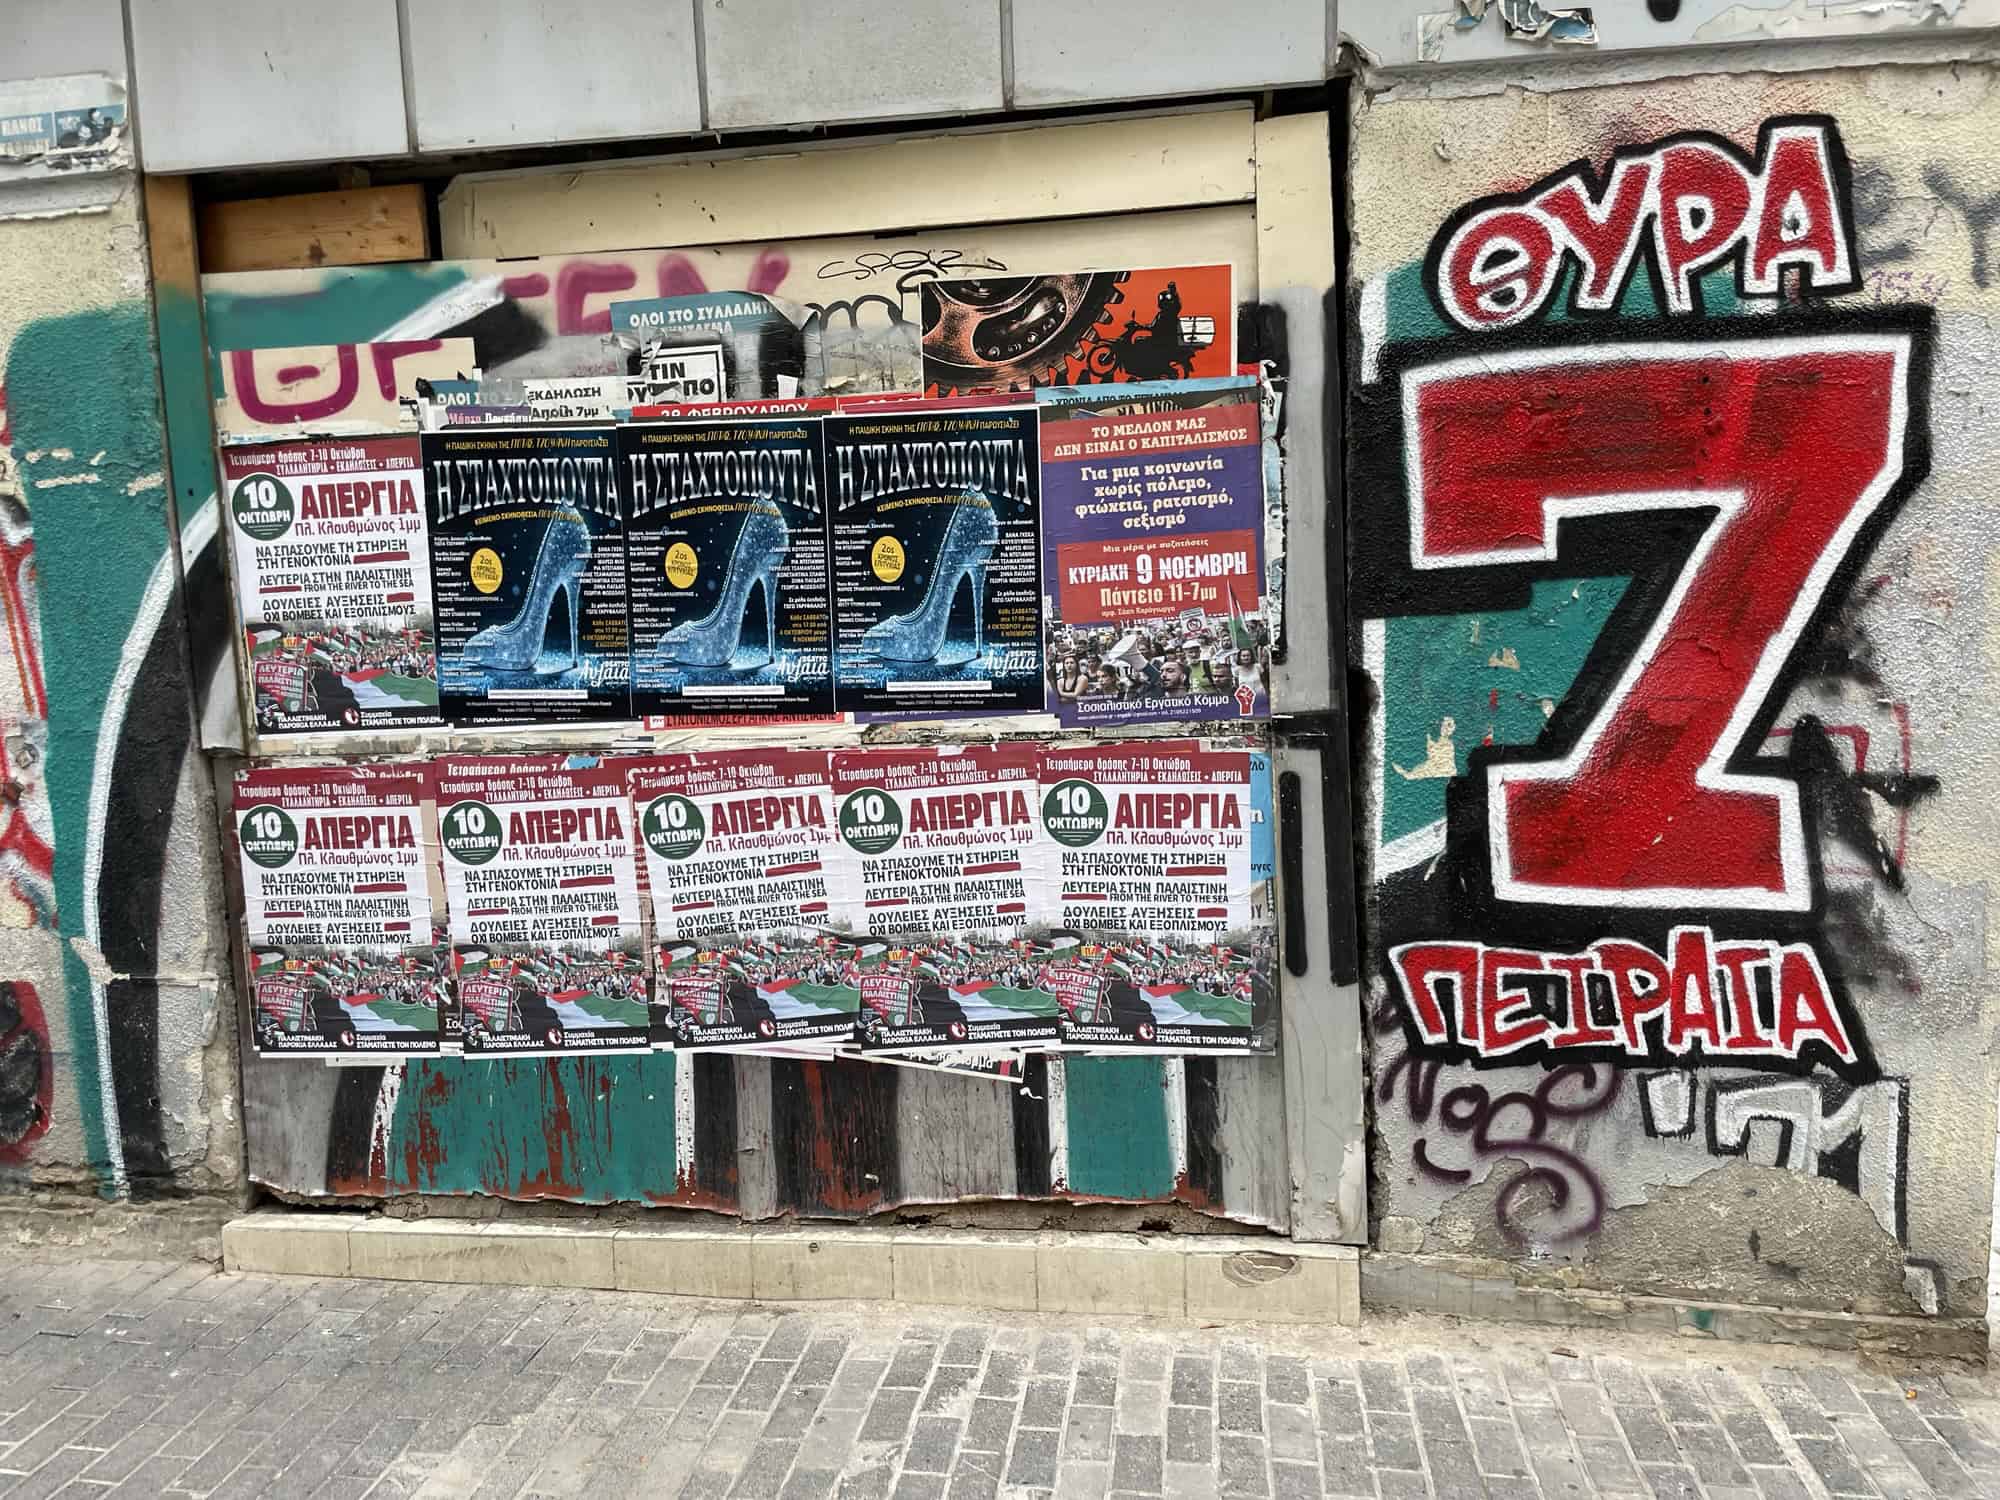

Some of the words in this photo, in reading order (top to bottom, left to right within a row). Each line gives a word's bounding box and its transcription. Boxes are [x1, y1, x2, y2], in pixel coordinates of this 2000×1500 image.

[1438, 126, 1856, 333] ΘΥΡΑ
[630, 312, 664, 327] ΟΛΟΙ
[668, 309, 693, 322] ΣΤΟ
[1092, 427, 1109, 437] ΤΟ
[1114, 424, 1172, 436] ΜΕΛΛΟΝ
[1176, 418, 1206, 429] ΜΑΣ
[1054, 445, 1080, 456] ΔΕΝ
[1085, 442, 1124, 454] ΕΙΝΑΙ
[1129, 441, 1137, 449] Ο
[1142, 429, 1247, 448] ΚΑΠΙΤΑΛΙΣΜΟΣ
[836, 446, 856, 512] Η
[860, 439, 1032, 506] ΣΤΑΧΤΟΠΟΥΤΑ
[1081, 467, 1107, 481] Για
[1112, 465, 1139, 482] μια
[1144, 455, 1223, 475] κοινωνία
[243, 480, 277, 510] 10
[434, 460, 455, 525] Η
[457, 454, 622, 522] ΣΤΑΧΤΟΠΟΥΤΑ
[629, 454, 650, 519] Η
[653, 447, 821, 514] ΣΤΑΧΤΟΠΟΥΤΑ
[1094, 481, 1141, 497] χωρίς
[1147, 477, 1211, 493] πόλεμο,
[301, 479, 418, 521] ΑΠΕΡΓΙΑ
[1075, 499, 1148, 518] φτώχεια,
[1153, 489, 1234, 511] ρατσισμό,
[238, 509, 291, 525] ΟΚΤΩΒΡΗ
[295, 522, 314, 536] Πλ.
[318, 518, 395, 538] Κλαυθμώνος
[399, 516, 421, 532] 1μμ
[1123, 510, 1186, 530] σεξισμό
[258, 573, 311, 587] ΛΕΥΤΕΡΙΑ
[312, 571, 342, 584] ΣΤΗΝ
[346, 567, 411, 582] ΠΑΛΑΙΣΤΙΝΗ
[1069, 564, 1129, 584] ΚΥΡΙΑΚΗ
[1136, 554, 1152, 584] 9
[1159, 552, 1247, 580] ΝΟΕΜΒΡΗ
[1100, 585, 1162, 607] Πάντειο
[1170, 582, 1216, 601] 11-7μμ
[1401, 334, 1911, 912] 7
[1077, 699, 1142, 714] Σοσιαλιστικό
[1145, 696, 1191, 712] Εργατικό
[1194, 694, 1229, 707] Κόμμα
[851, 795, 885, 824] 10
[909, 790, 1031, 833] ΑΠΕΡΓΙΑ
[1057, 787, 1090, 815] 10
[1114, 794, 1241, 829] ΑΠΕΡΓΙΑ
[251, 812, 282, 839] 10
[453, 807, 486, 835] 10
[506, 806, 623, 846] ΑΠΕΡΓΙΑ
[654, 801, 688, 831] 10
[711, 794, 826, 838] ΑΠΕΡΓΙΑ
[1048, 817, 1103, 829] ΟΚΤΩΒΡΗ
[302, 815, 415, 851] ΑΠΕΡΓΙΑ
[448, 835, 499, 850] ΟΚΤΩΒΡΗ
[650, 827, 701, 846] ΟΚΤΩΒΡΗ
[705, 839, 726, 853] Πλ.
[729, 829, 807, 854] Κλαυθμώνος
[845, 822, 899, 839] ΟΚΤΩΒΡΗ
[903, 835, 923, 849] Πλ.
[927, 828, 1006, 850] Κλαυθμώνος
[1010, 826, 1033, 843] 1μμ
[1107, 831, 1127, 844] Πλ.
[1132, 831, 1214, 847] Κλαυθμώνος
[1219, 831, 1242, 847] 1μμ
[246, 839, 295, 853] ΟΚΤΩΒΡΗ
[502, 848, 522, 861] Πλ.
[525, 843, 601, 863] Κλαυθμώνος
[604, 842, 626, 858] 1μμ
[298, 853, 317, 865] Πλ.
[320, 851, 393, 867] Κλαυθμώνος
[397, 850, 418, 865] 1μμ
[1063, 853, 1078, 863] ΝΑ
[1081, 853, 1148, 864] ΣΠΑΣΟΥΜΕ
[1151, 853, 1168, 864] ΤΗ
[1171, 853, 1225, 865] ΣΤΗΡΙΞΗ
[1062, 865, 1085, 876] ΣΤΗ
[1088, 865, 1163, 877] ΓΕΝΟΚΤΟΝΙΑ
[671, 888, 724, 905] ΛΕΥΤΕΡΙΑ
[724, 885, 754, 899] ΣΤΗΝ
[758, 877, 824, 895] ΠΑΛΑΙΣΤΙΝΗ
[864, 886, 919, 900] ΛΕΥΤΕΡΙΑ
[920, 883, 950, 896] ΣΤΗΝ
[955, 877, 1023, 893] ΠΑΛΑΙΣΤΙΝΗ
[1062, 882, 1118, 893] ΛΕΥΤΕΡΙΑ
[1120, 882, 1151, 893] ΣΤΗΝ
[1156, 883, 1227, 893] ΠΑΛΑΙΣΤΙΝΗ
[1134, 894, 1151, 902] THE
[1154, 894, 1178, 903] RIVER
[1180, 895, 1192, 903] TO
[1194, 895, 1210, 903] THE
[1211, 895, 1228, 903] SEA
[263, 900, 313, 912] ΛΕΥΤΕΡΙΑ
[314, 900, 342, 911] ΣΤΗΝ
[346, 898, 408, 910] ΠΑΛΑΙΣΤΙΝΗ
[466, 897, 518, 910] ΛΕΥΤΕΡΙΑ
[519, 895, 548, 907] ΣΤΗΝ
[552, 891, 616, 905] ΠΑΛΑΙΣΤΙΝΗ
[1064, 907, 1127, 918] ΔΟΥΛΕΙΕΣ
[1132, 908, 1195, 919] ΑΥΞΗΣΕΙΣ
[1064, 919, 1080, 929] ΟΧΙ
[1084, 919, 1127, 929] ΒΟΜΒΕΣ
[1130, 920, 1147, 930] ΚΑΙ
[1150, 920, 1228, 931] ΕΞΟΠΛΙΣΜΟΥΣ
[1389, 926, 1858, 1065] ΠΕΙΡΑΙΑ
